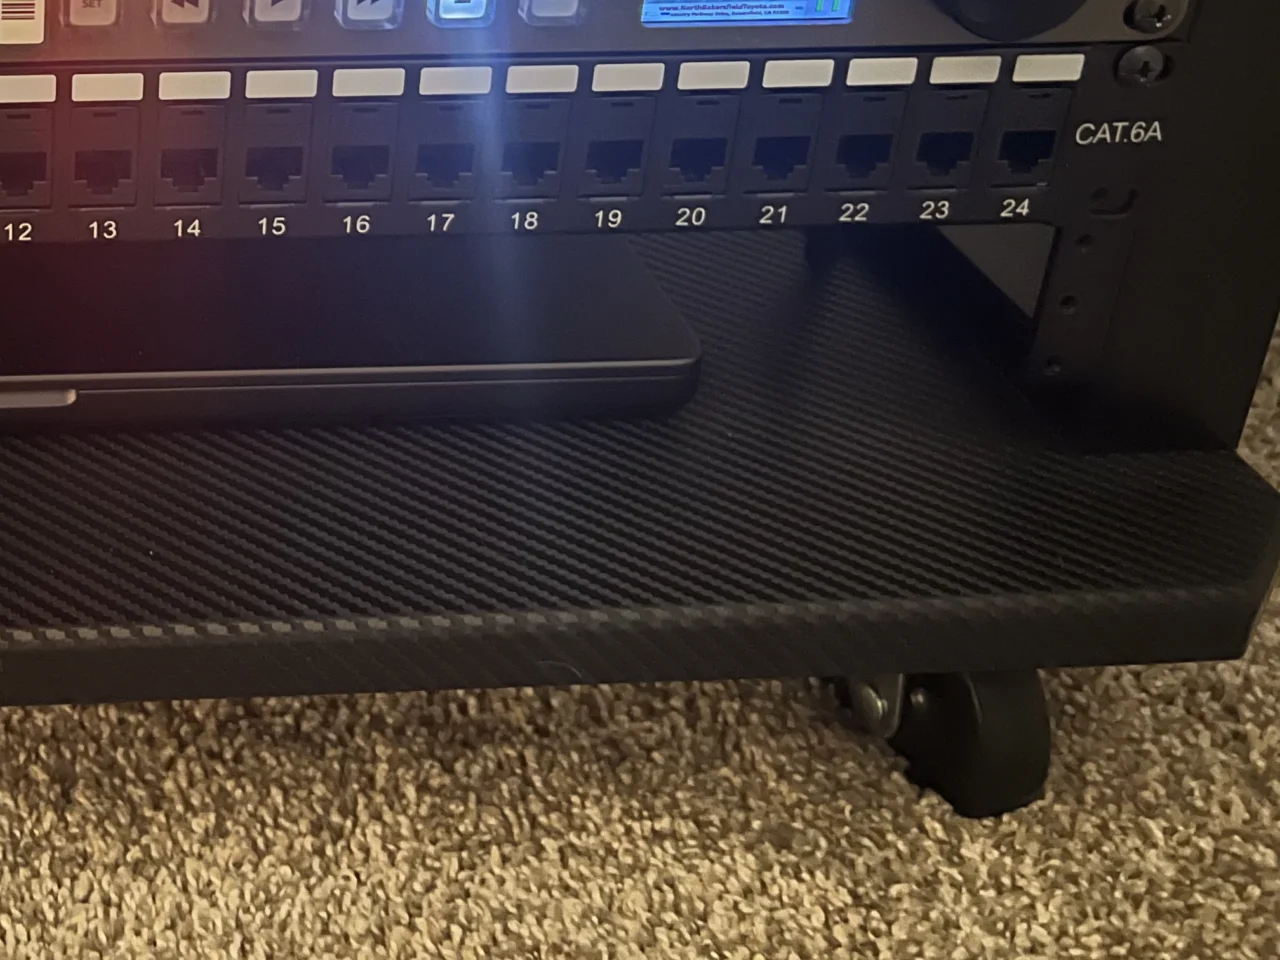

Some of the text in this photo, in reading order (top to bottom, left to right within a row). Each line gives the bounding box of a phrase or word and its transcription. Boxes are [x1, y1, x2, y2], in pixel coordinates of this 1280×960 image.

[1076, 121, 1162, 144] CAT.6A
[4, 222, 32, 241] 12
[88, 220, 117, 239] 13
[173, 219, 201, 237] 14
[258, 218, 286, 236] 15
[342, 216, 370, 234] 16
[427, 214, 454, 232] 17
[511, 212, 538, 230] 18
[594, 209, 622, 228] 19
[676, 208, 705, 226] 20
[759, 206, 788, 224] 21
[838, 203, 870, 222] 22
[919, 201, 950, 218] 23
[1000, 200, 1030, 218] 24
